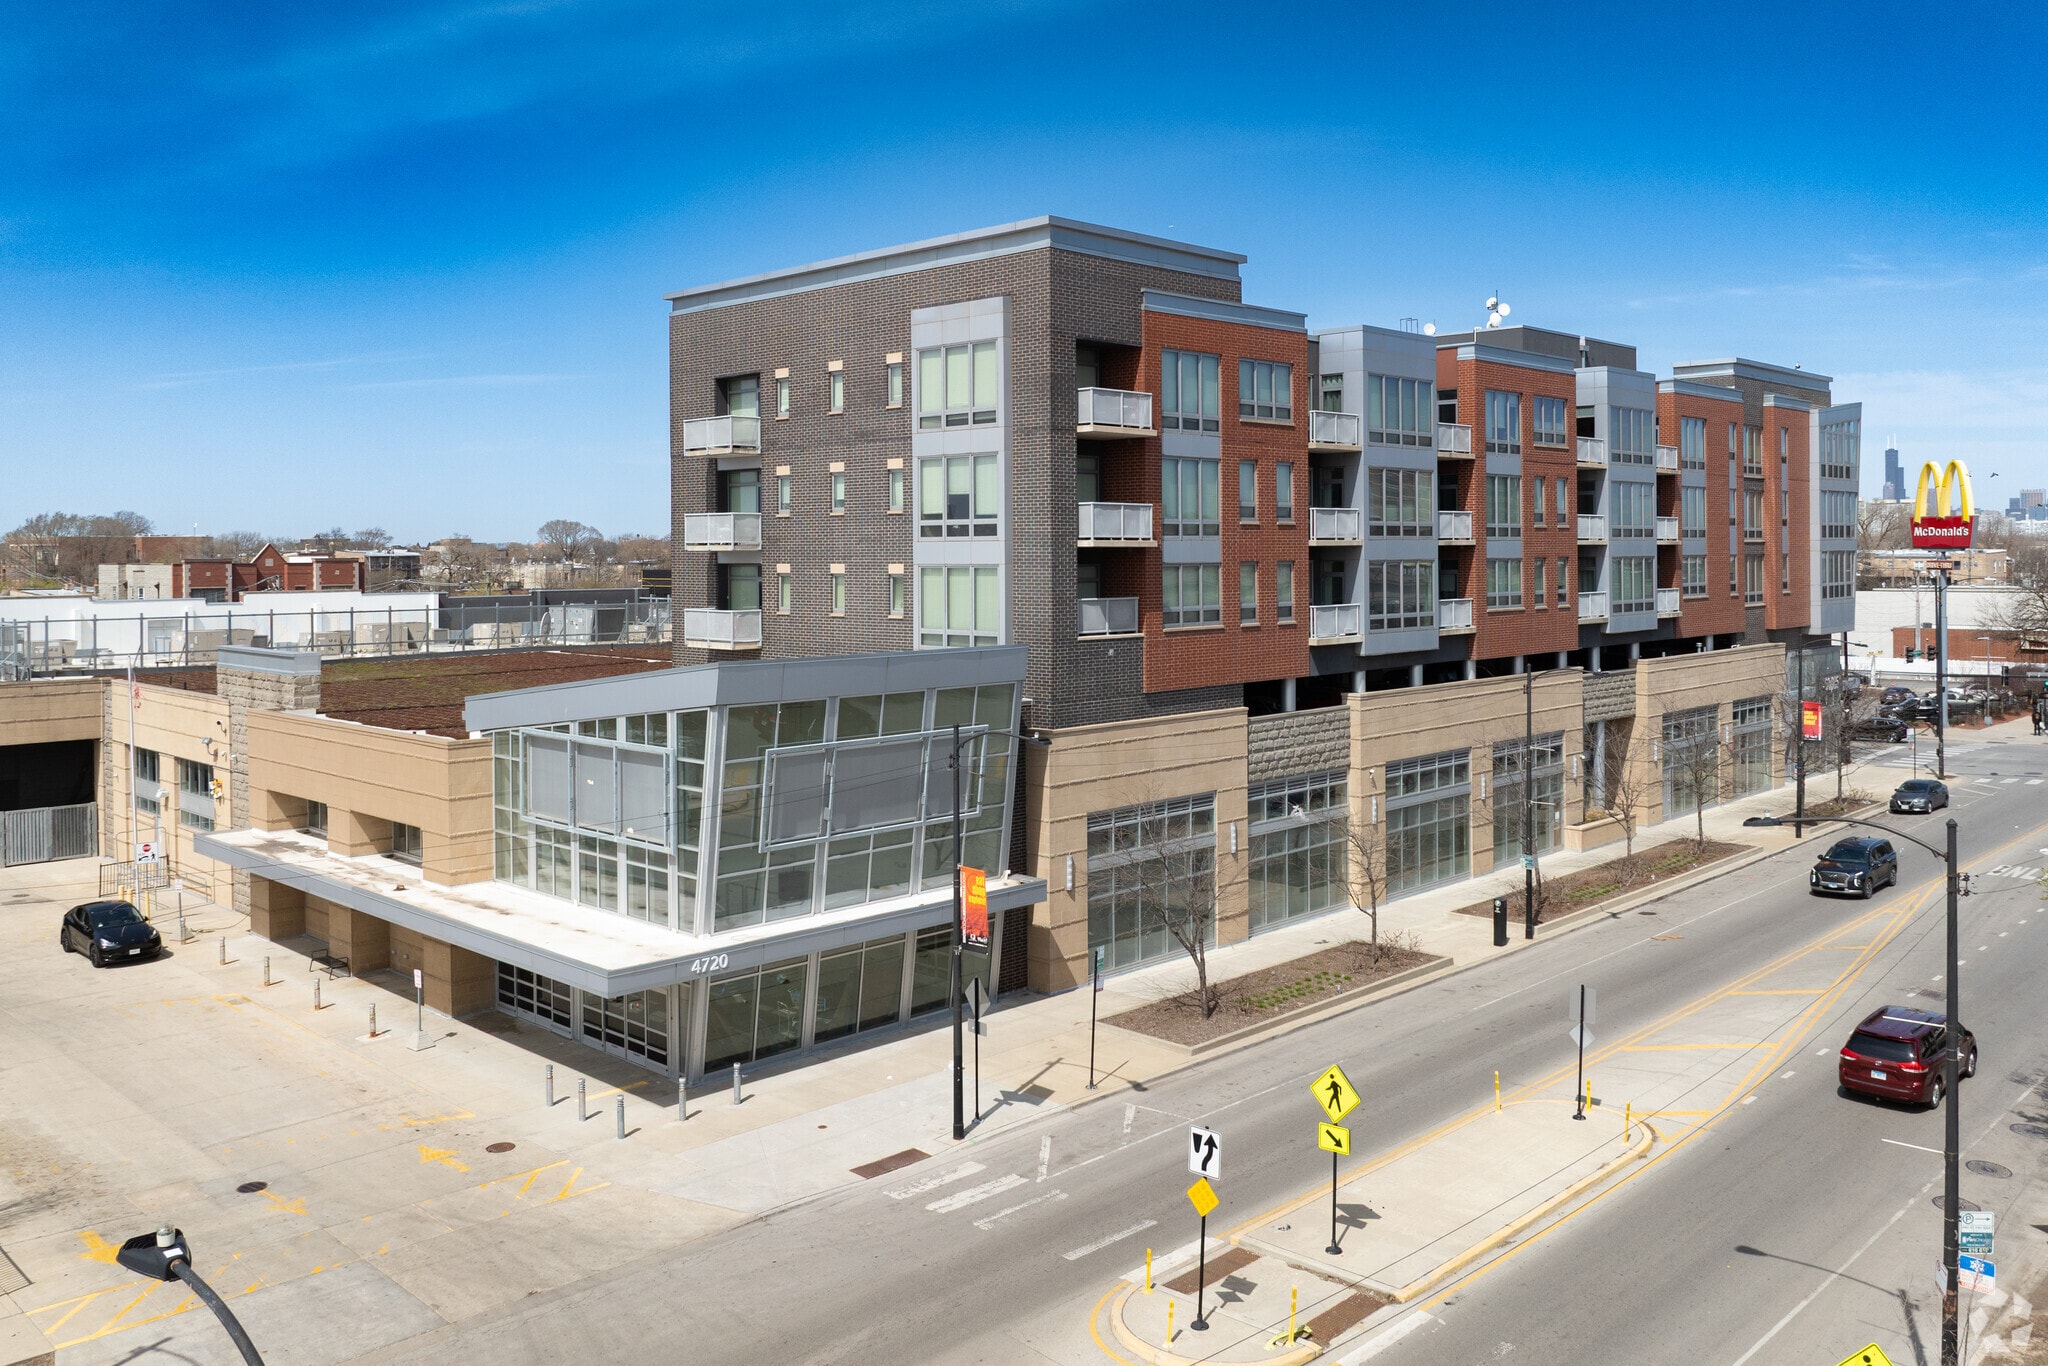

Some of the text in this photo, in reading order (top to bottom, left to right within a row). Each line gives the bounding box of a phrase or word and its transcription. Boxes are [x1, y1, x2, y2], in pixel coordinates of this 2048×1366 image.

[1914, 527, 1969, 536] McDonald's
[1987, 865, 2046, 881] ONL
[691, 954, 729, 973] 4720
